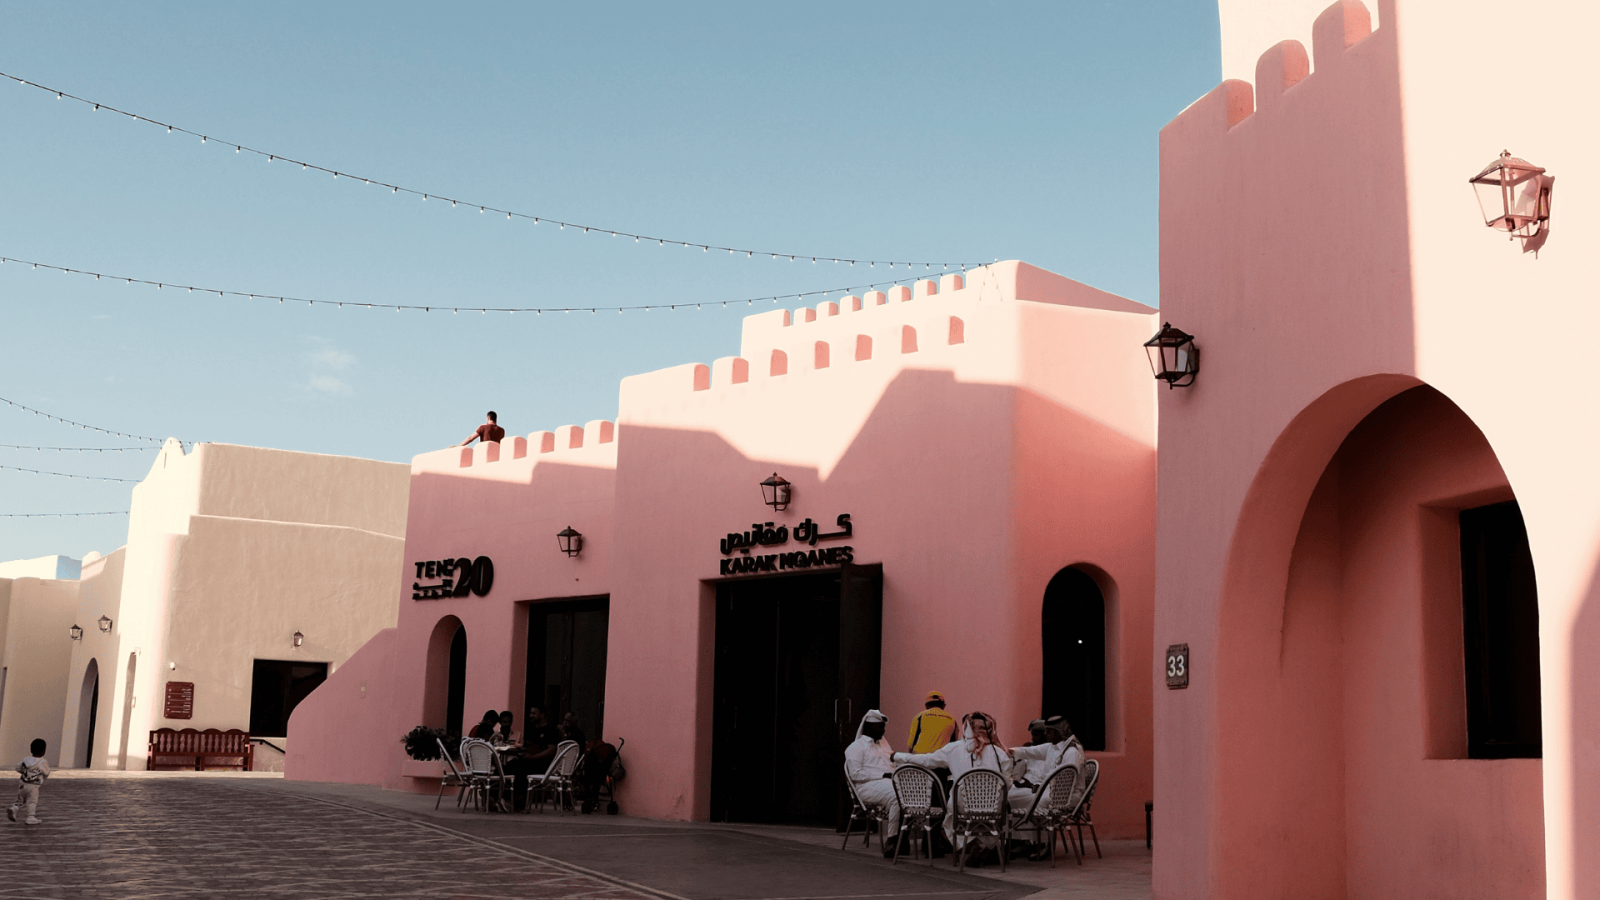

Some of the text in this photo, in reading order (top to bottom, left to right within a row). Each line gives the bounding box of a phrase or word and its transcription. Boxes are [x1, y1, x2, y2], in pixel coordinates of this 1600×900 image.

[793, 513, 853, 545] كرك
[452, 555, 494, 598] 20
[720, 554, 778, 575] KARAK
[1168, 654, 1185, 677] 33
